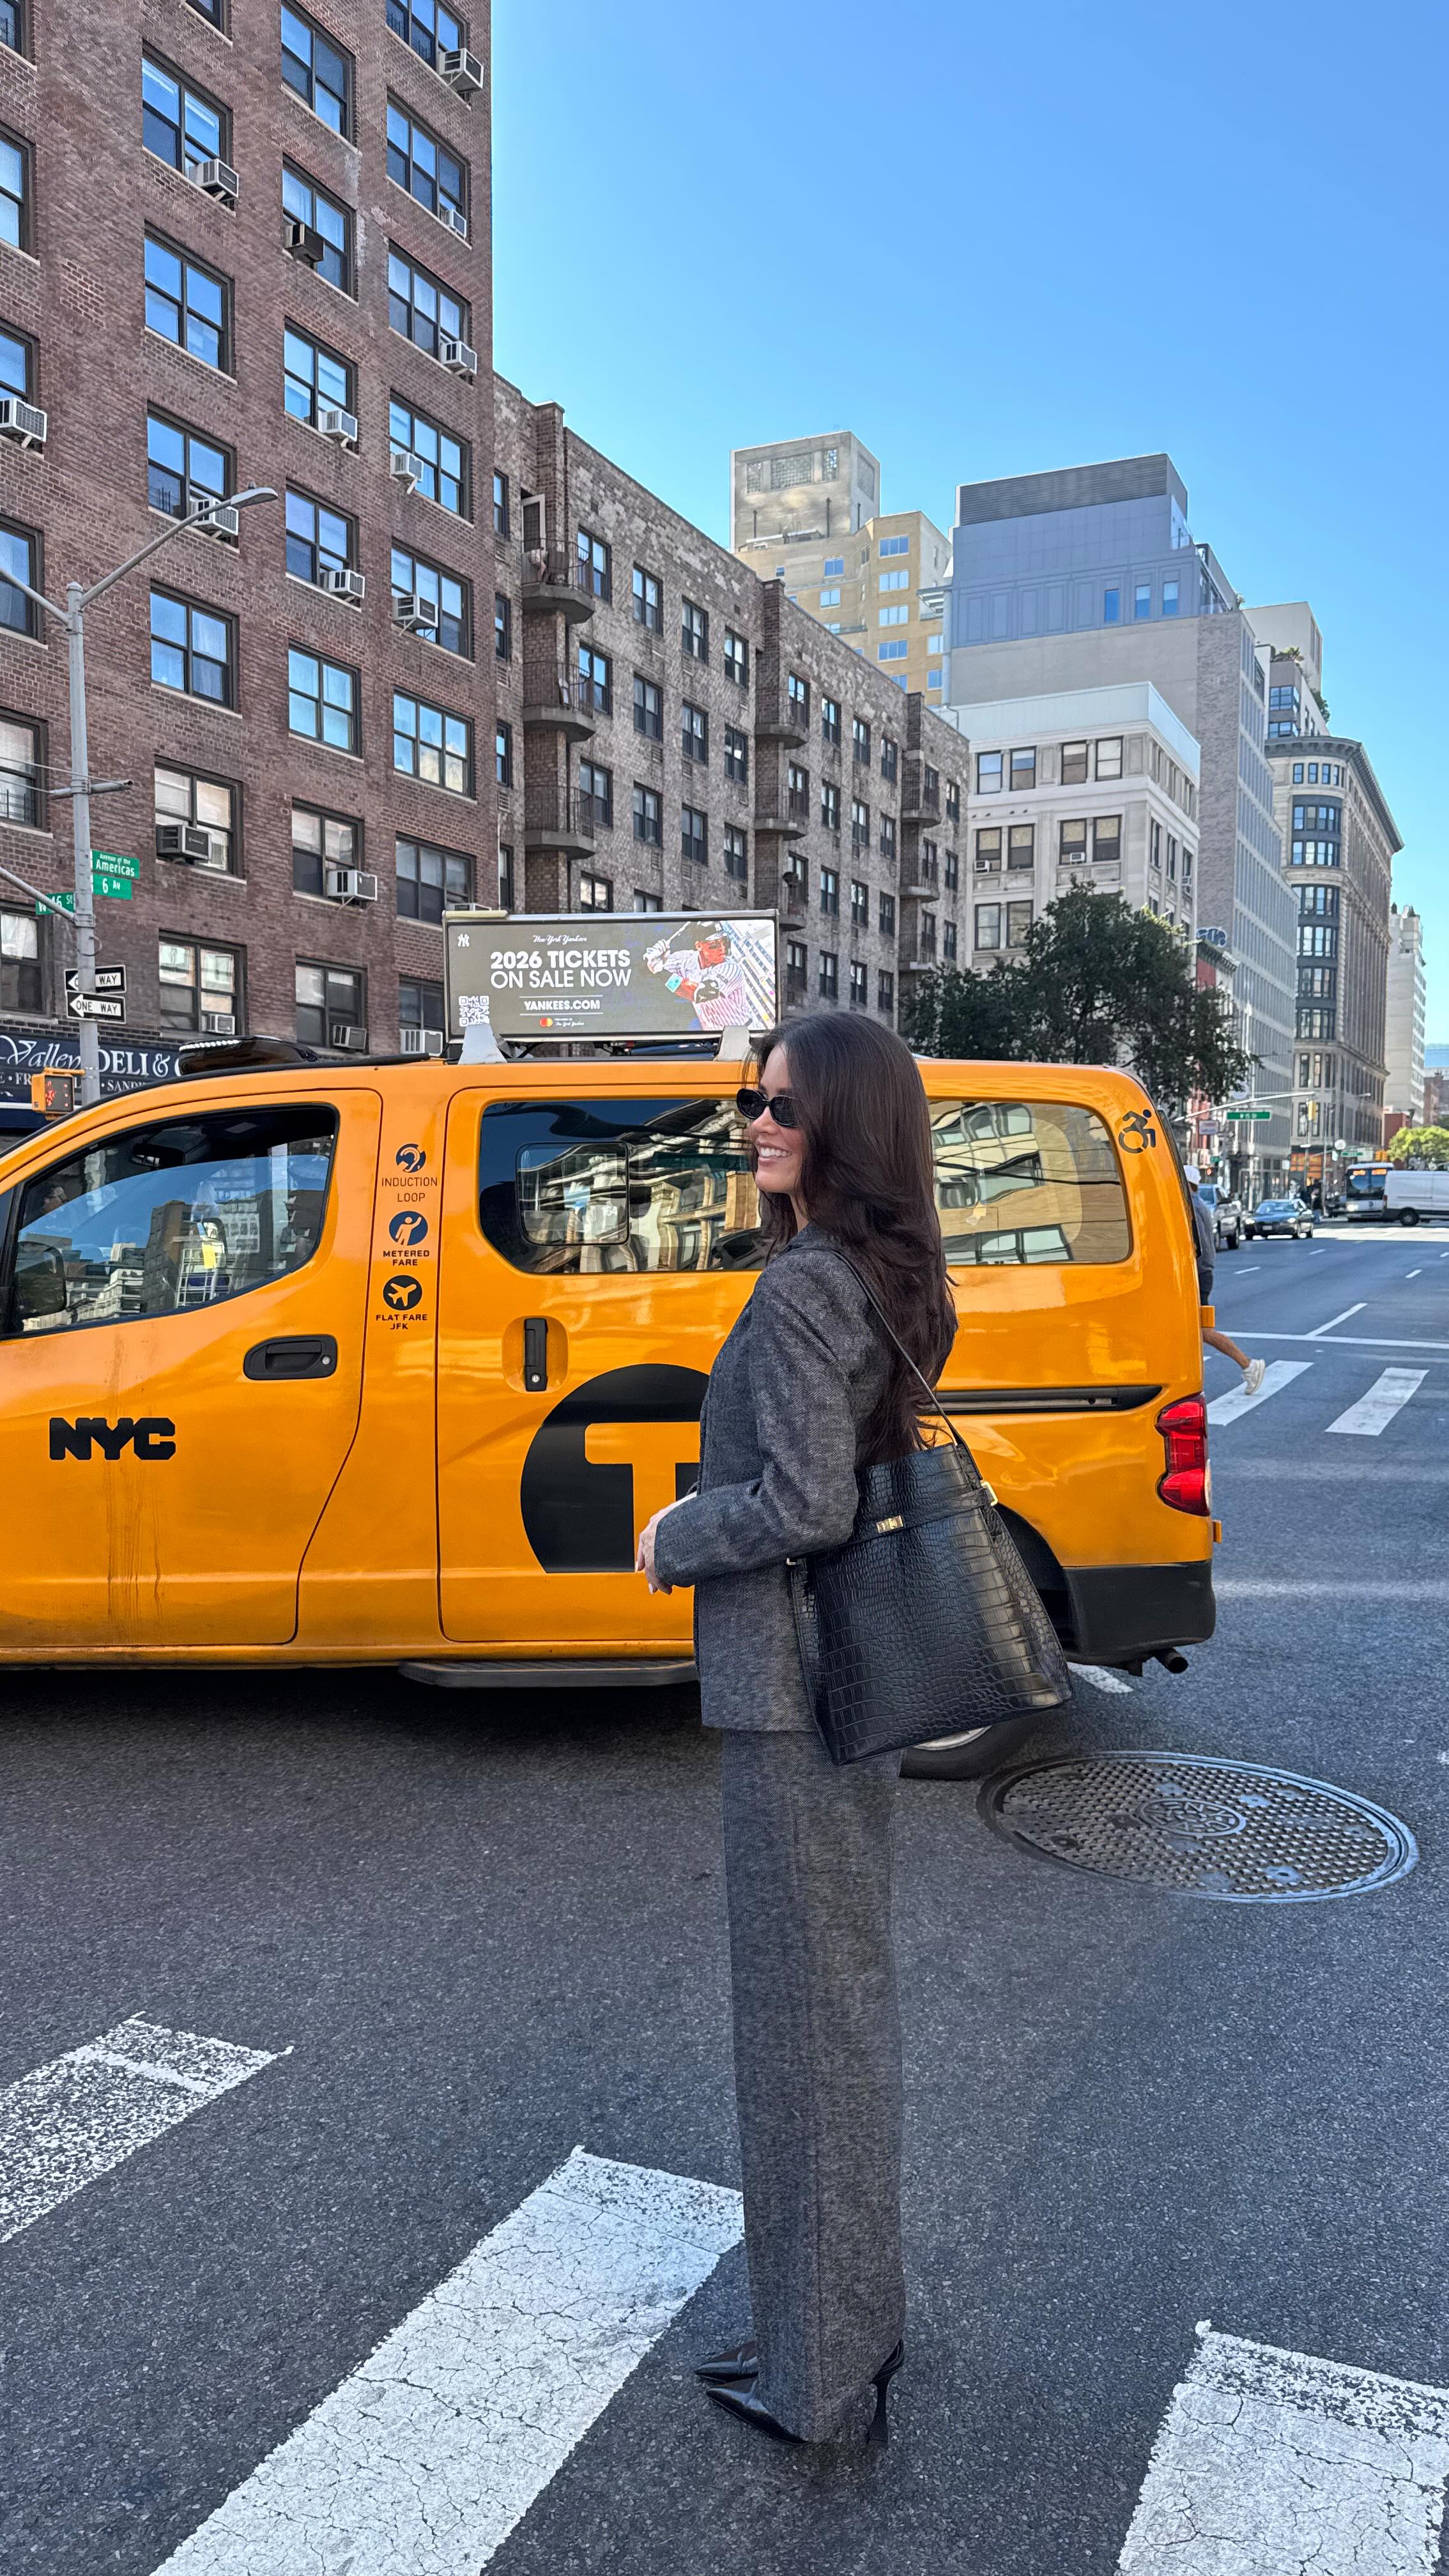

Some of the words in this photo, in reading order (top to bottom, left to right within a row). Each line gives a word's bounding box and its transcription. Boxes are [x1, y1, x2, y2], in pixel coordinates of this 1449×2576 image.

[100, 854, 116, 862] Avenue
[96, 859, 135, 877] Americas
[102, 878, 108, 894] 6
[112, 880, 121, 891] Av
[66, 894, 73, 904] St
[547, 935, 562, 946] York
[562, 934, 587, 946] Yankees
[491, 951, 542, 969] 2026
[547, 949, 631, 969] TICKETS
[99, 974, 118, 985] WAY
[491, 970, 523, 989] ON
[529, 970, 574, 988] SALE
[580, 969, 632, 987] NOW
[76, 1000, 93, 1012] ONE
[100, 1002, 118, 1015] WAY
[524, 999, 601, 1011] YANKEES.COM
[152, 1053, 171, 1078] &
[381, 1177, 438, 1187] INDUCTION
[397, 1193, 425, 1202] LOOP
[49, 1416, 176, 1460] NYC
